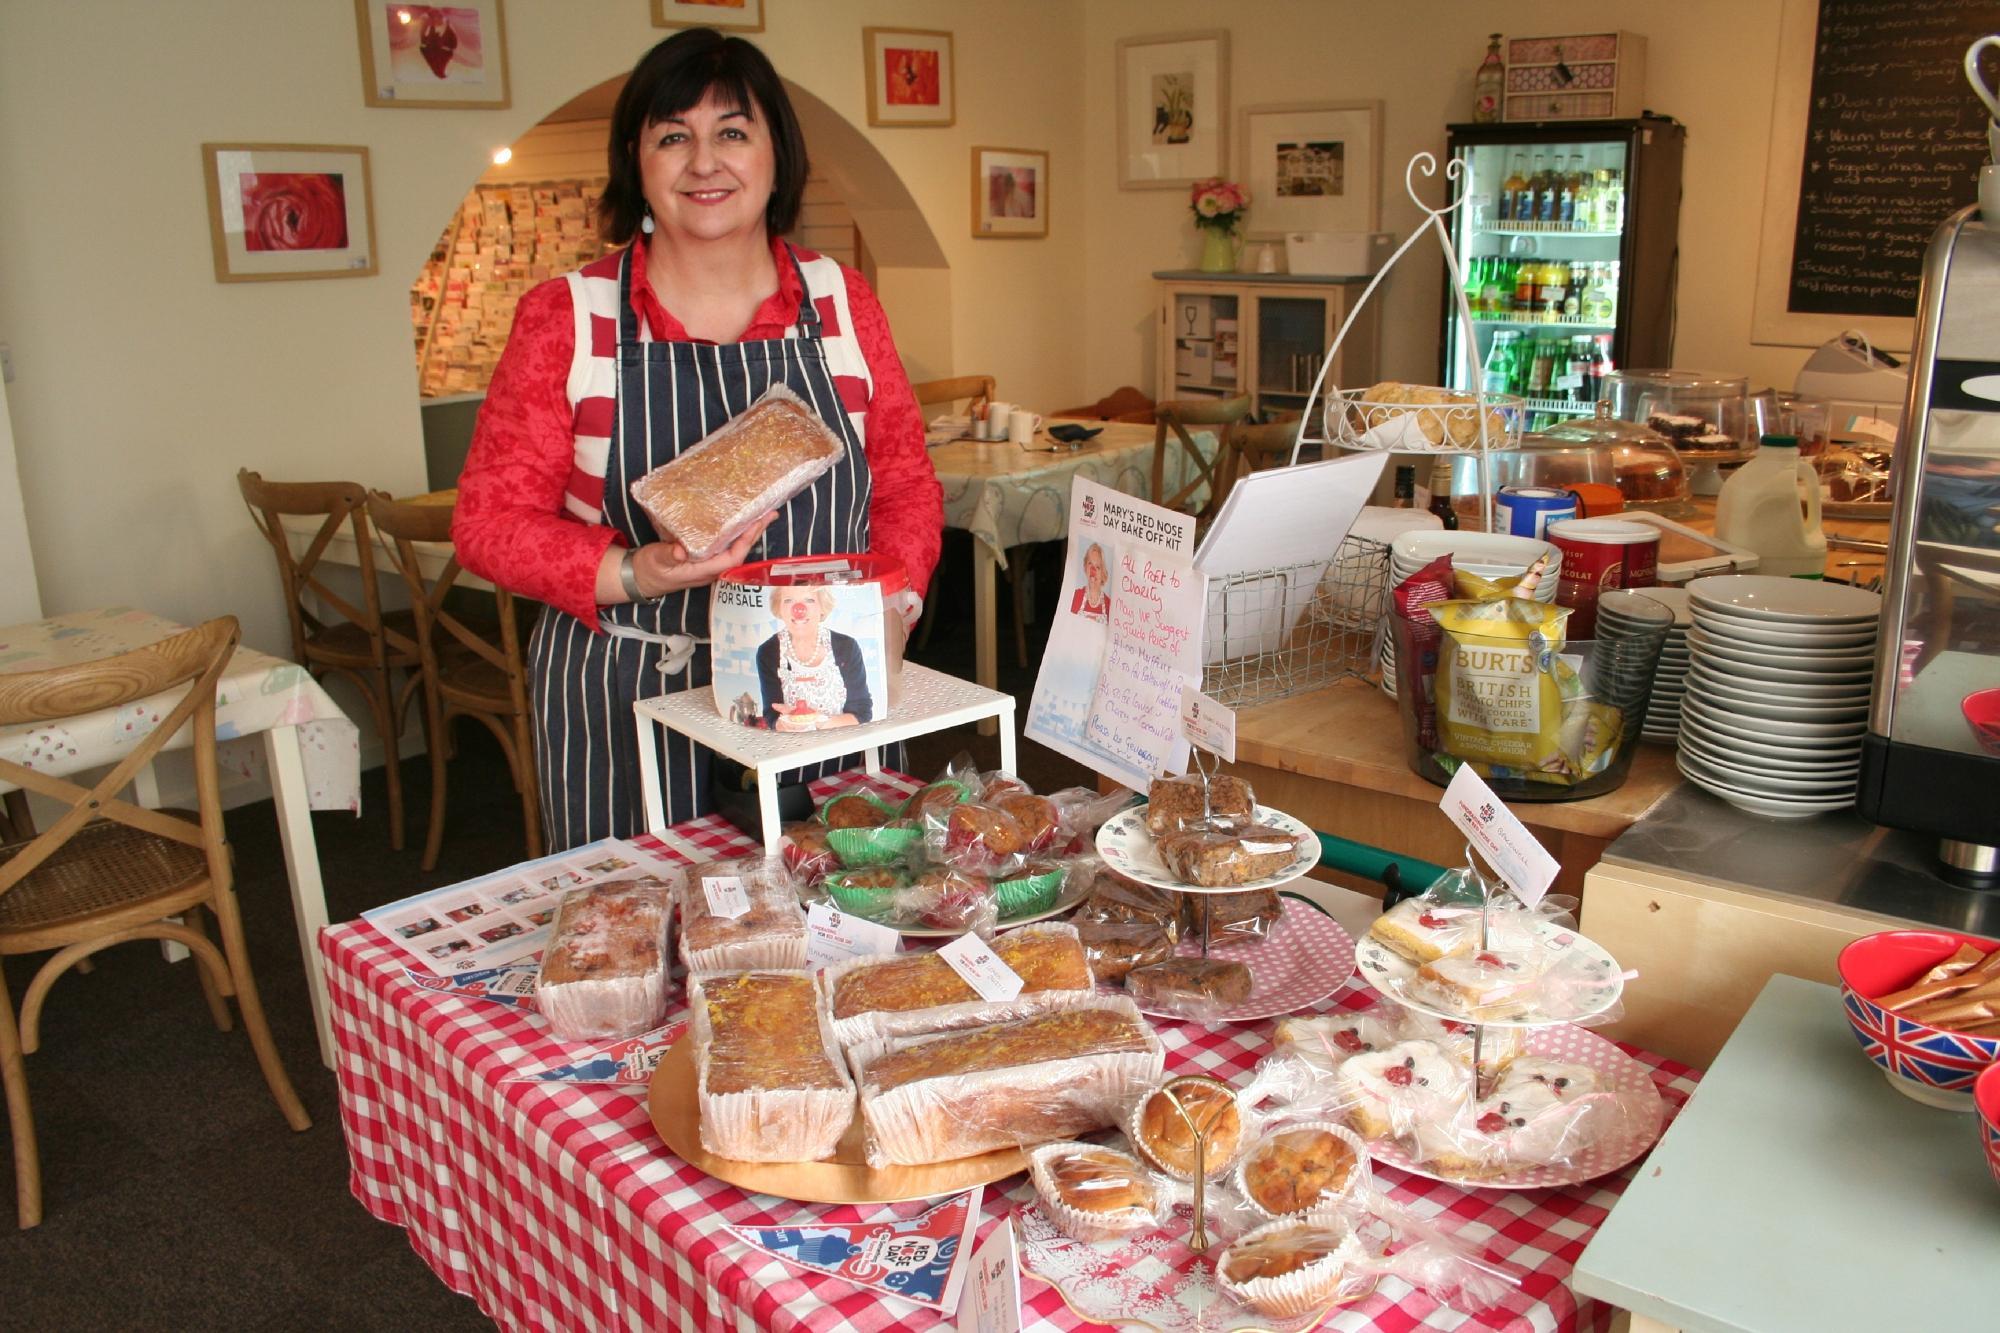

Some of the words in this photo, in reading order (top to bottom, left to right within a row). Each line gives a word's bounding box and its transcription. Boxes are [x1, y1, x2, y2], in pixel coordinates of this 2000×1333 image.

[1104, 502, 1134, 522] MARY'S
[1137, 513, 1155, 528] RED
[1157, 520, 1183, 538] NOSE
[1103, 515, 1119, 530] DAY
[1122, 521, 1143, 539] BAKE
[1146, 530, 1165, 545] OFF
[1166, 536, 1182, 551] KIT
[717, 591, 734, 605] FOR
[736, 593, 763, 608] SALE
[1456, 651, 1533, 673] BURTS
[1456, 677, 1532, 698] BRITISH
[1456, 689, 1494, 707] POTATO
[1498, 699, 1532, 709] CHIPS
[1457, 708, 1488, 725] WITH
[883, 1245, 901, 1262] DAY
[896, 1241, 918, 1267] NOSE
[913, 1245, 930, 1262] RED
